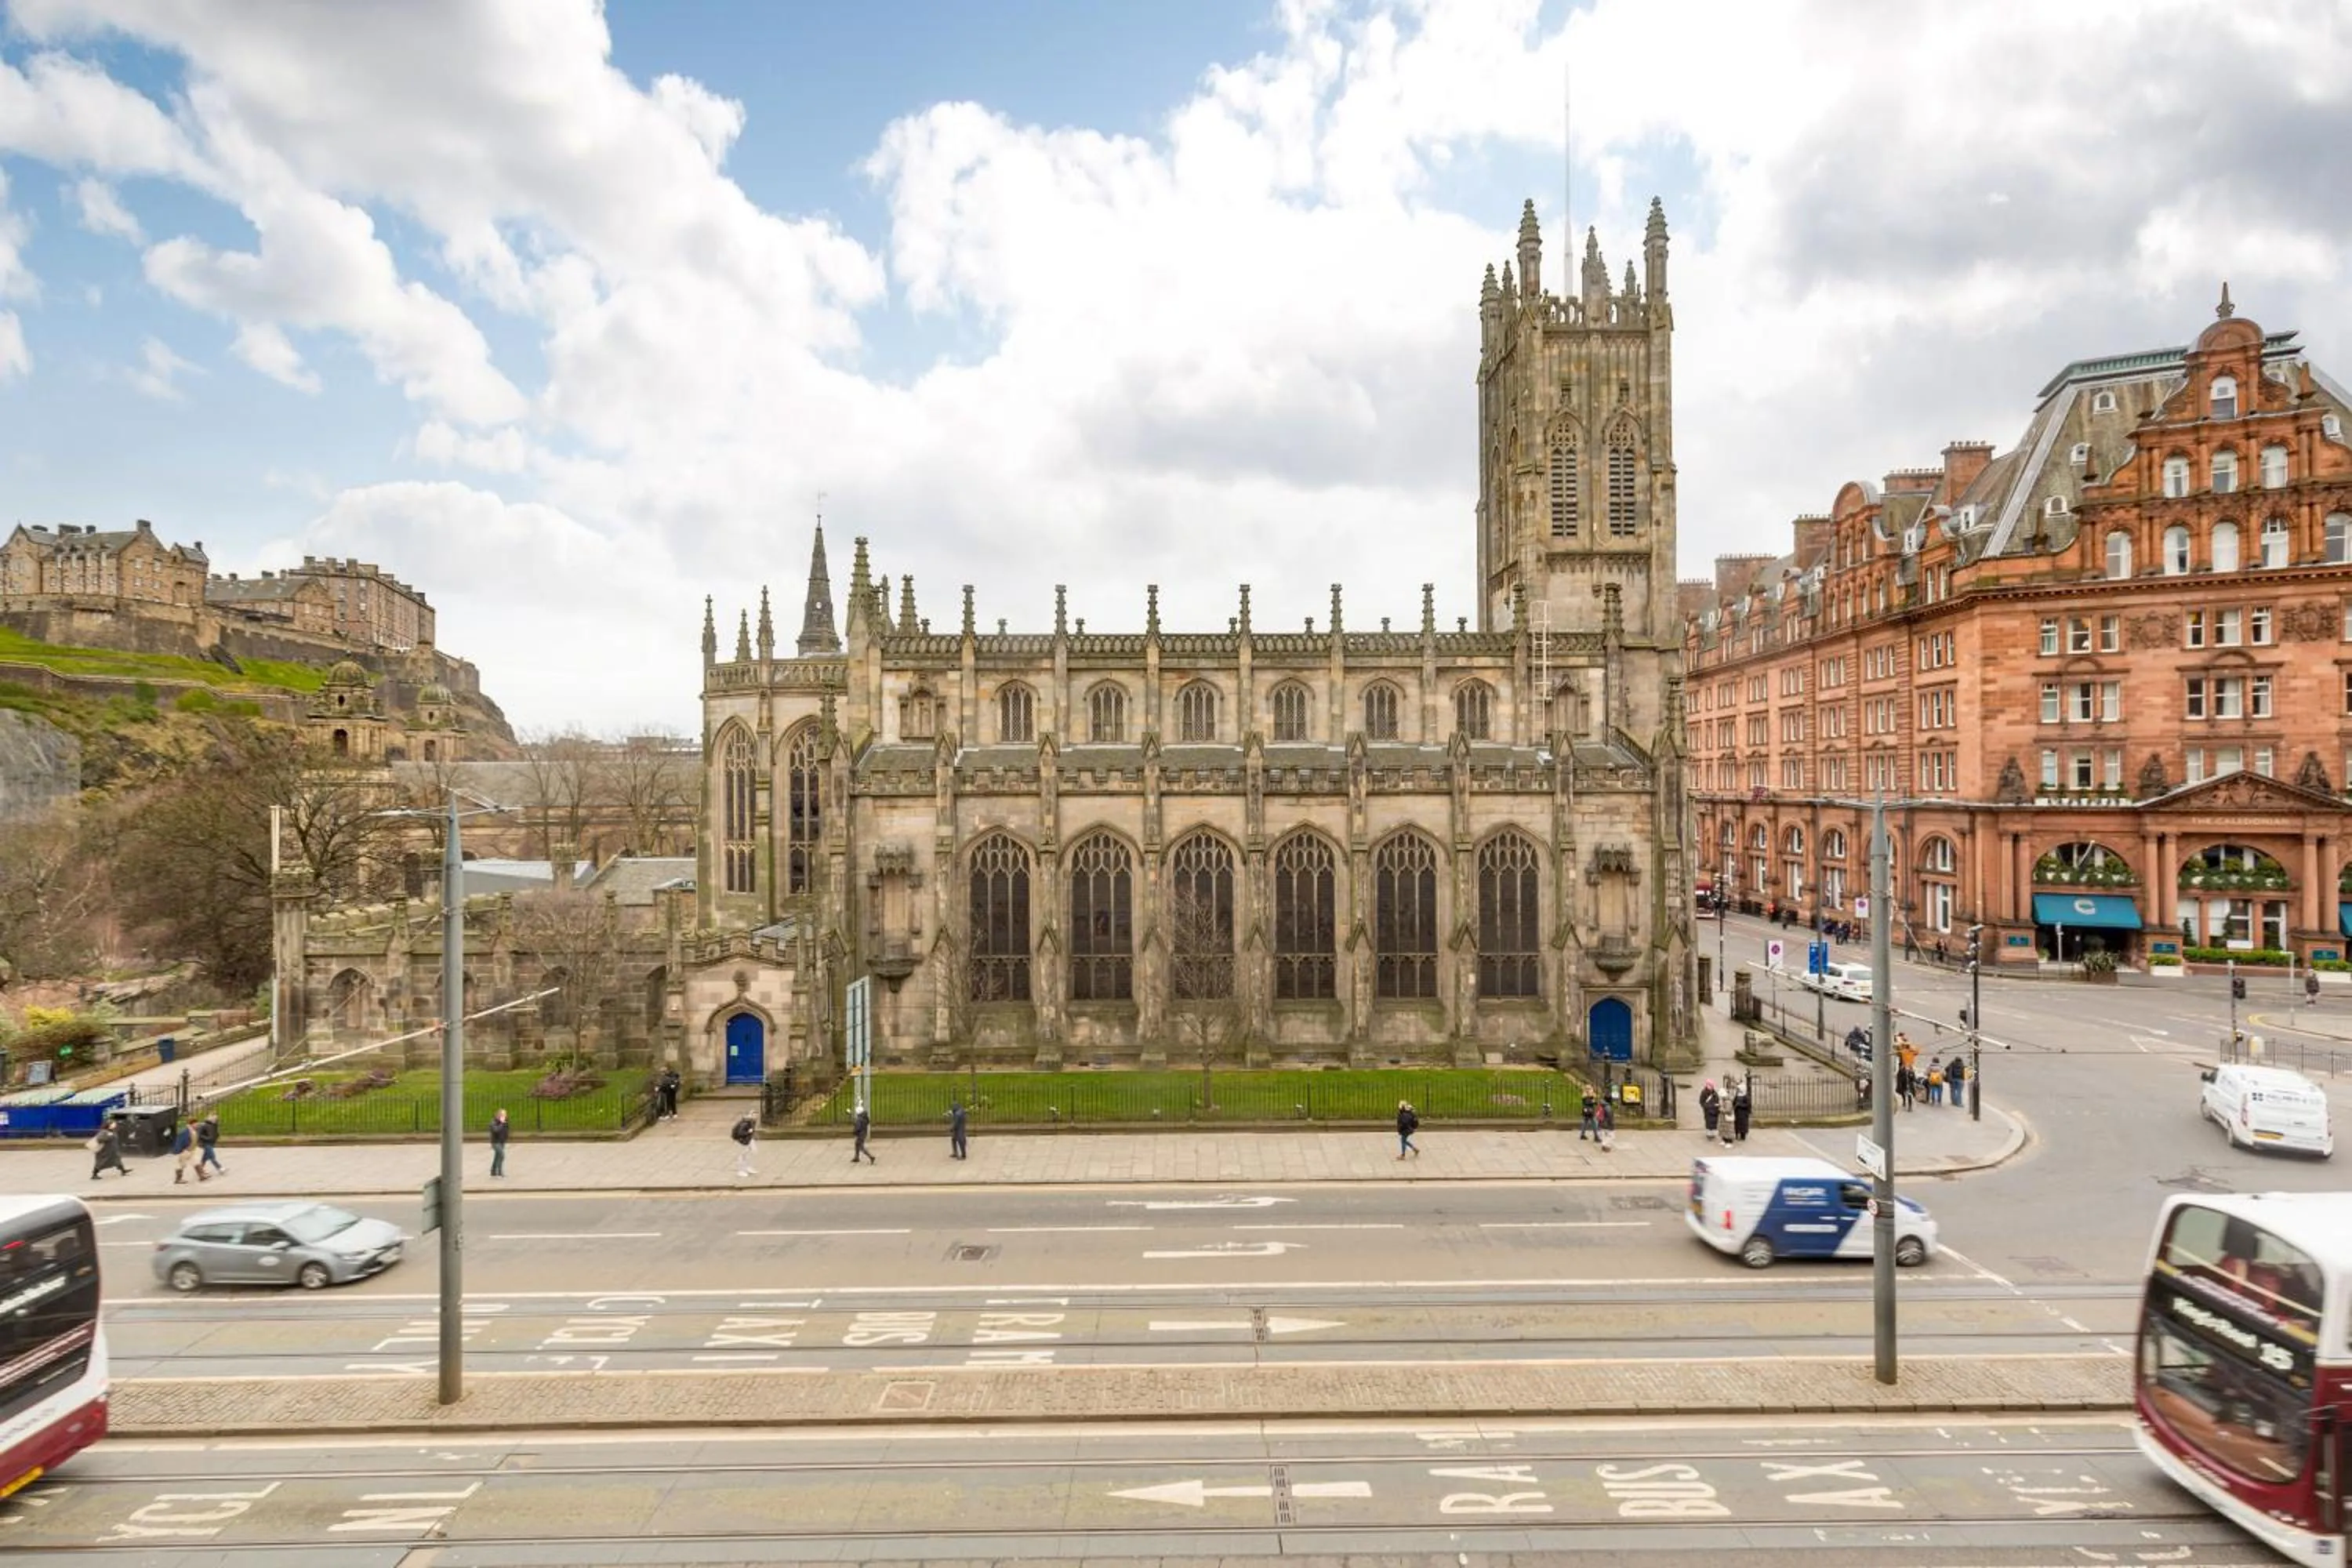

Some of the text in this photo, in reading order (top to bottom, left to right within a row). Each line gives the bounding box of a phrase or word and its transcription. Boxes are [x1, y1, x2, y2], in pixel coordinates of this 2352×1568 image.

[2215, 817, 2289, 826] CALEDONIAN
[691, 1298, 822, 1361] TAXI
[843, 1311, 938, 1347] BUS
[965, 1297, 1069, 1366] TRAM
[1596, 1463, 1732, 1517] BUS
